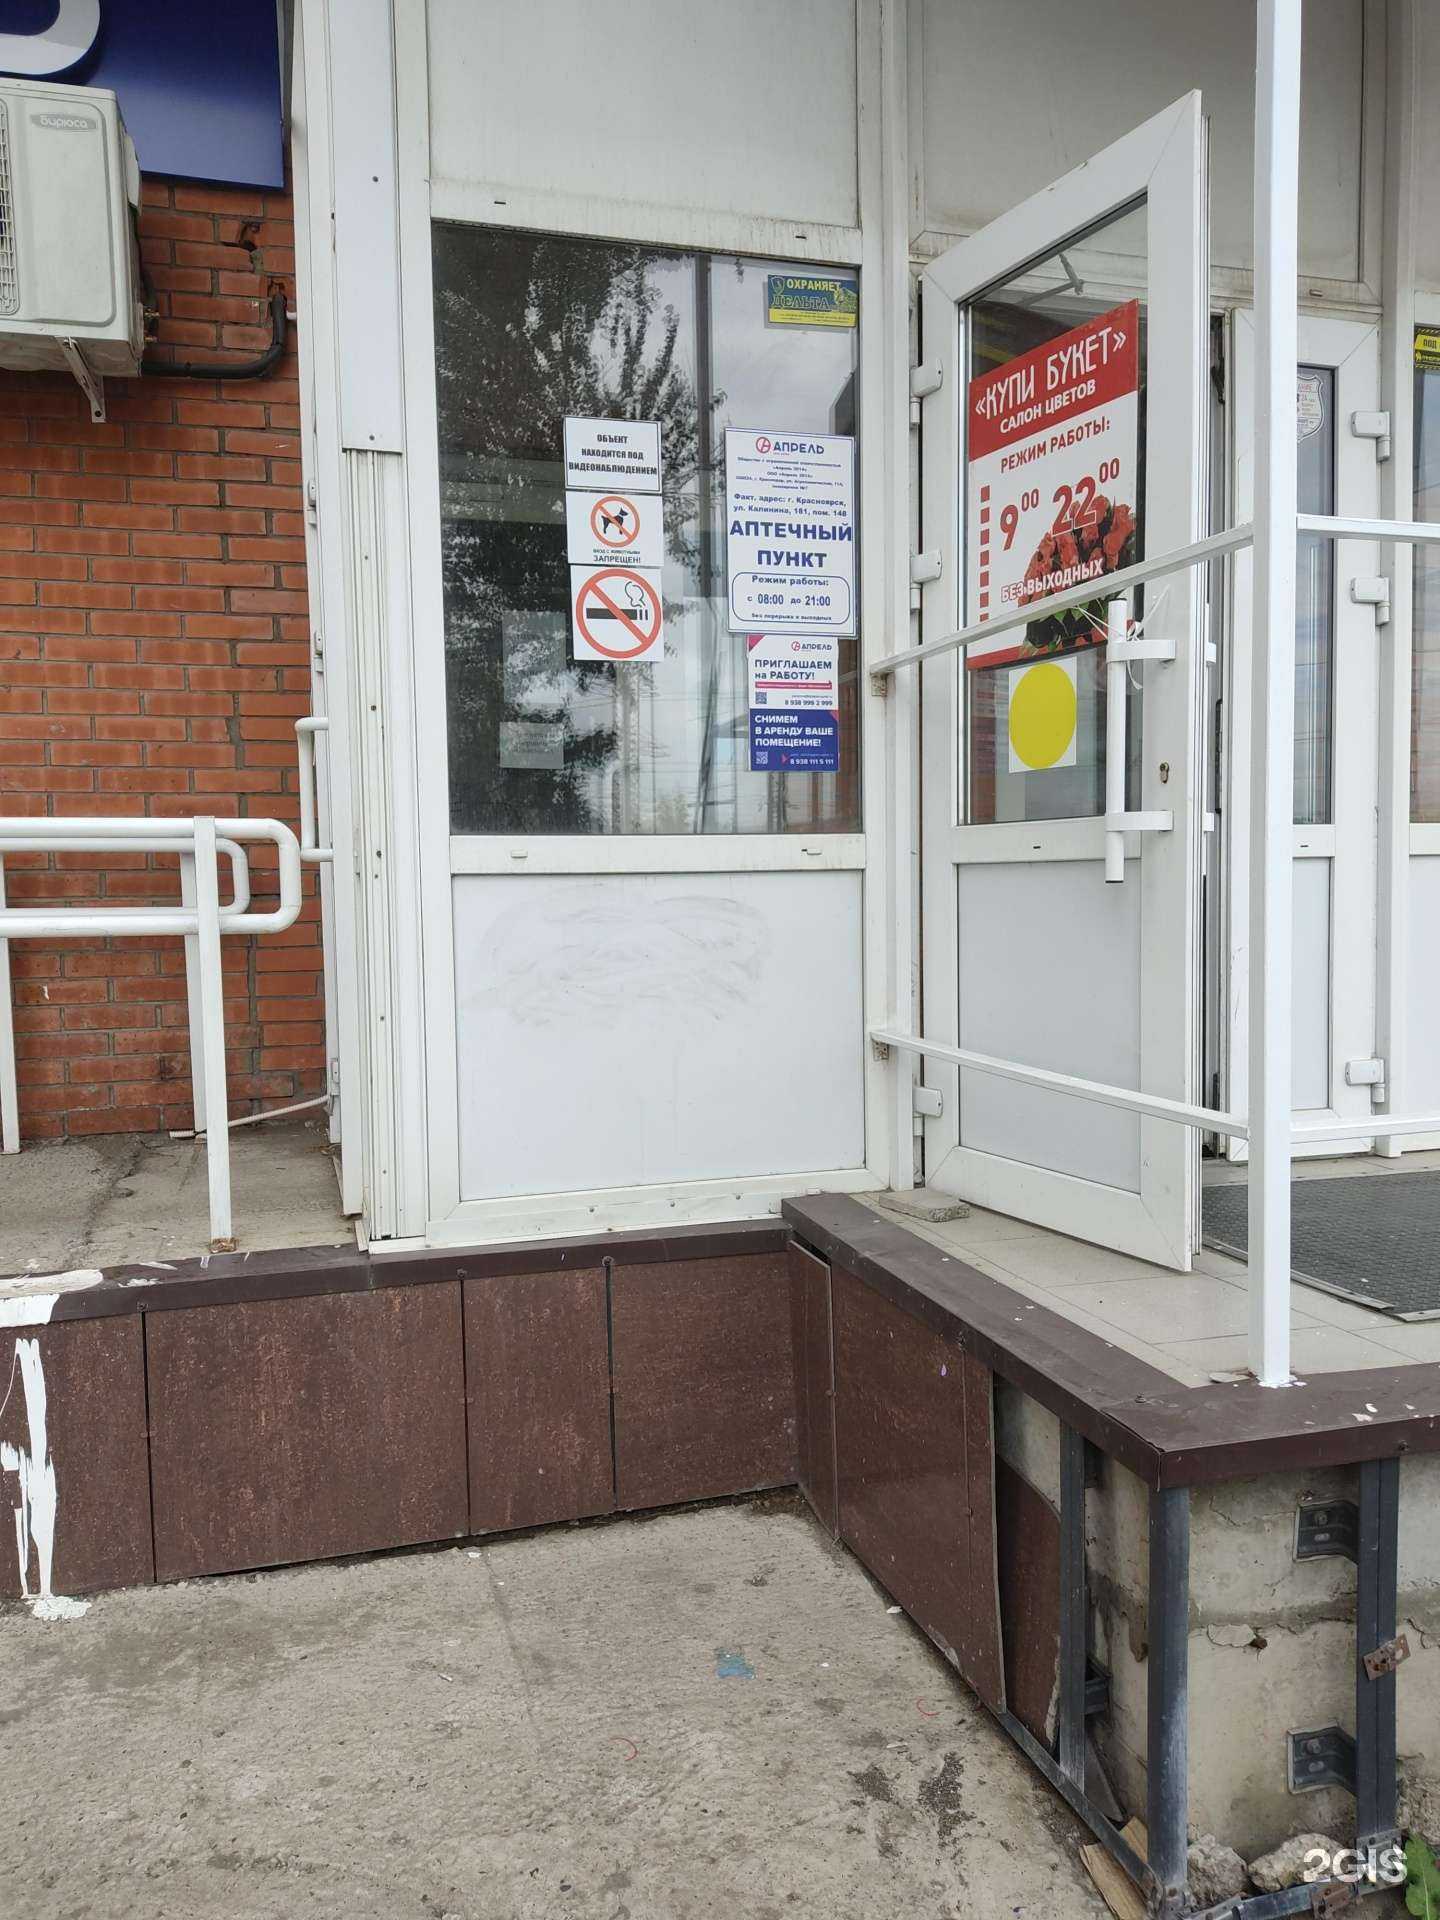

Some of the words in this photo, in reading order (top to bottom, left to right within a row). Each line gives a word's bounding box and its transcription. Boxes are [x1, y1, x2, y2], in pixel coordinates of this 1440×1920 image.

[787, 279, 841, 292] ОХРАНЯЕТ
[771, 294, 829, 310] ДЕЛЬТА
[975, 364, 1034, 420] «КУПИ
[1047, 326, 1127, 390] БУКЕТ»
[1000, 405, 1042, 433] САЛОН
[1045, 379, 1096, 415] ЦВЕТОВ
[597, 434, 628, 444] ОБЪЕКТ
[1001, 441, 1047, 473] РЕЖИМ
[1050, 417, 1110, 455] РАБОТЫ:
[774, 441, 824, 454] АПРЕЛЬ
[582, 448, 626, 459] НАХОДИТСЯ
[628, 451, 644, 460] ПОД
[569, 461, 657, 475] ВИДЕОНАБЛЮДЕНИЕМ
[734, 493, 756, 501] Факт.
[759, 495, 785, 504] адрес:
[796, 498, 846, 507] Красноярск,
[748, 505, 792, 515] Калинина,
[730, 520, 852, 541] АПТЕЧНЫЙ
[593, 555, 641, 564] ЗАПРЕЩЕН!
[757, 550, 827, 567] ПУНКТ
[752, 575, 786, 585] Режим
[790, 576, 829, 586] работы:
[1001, 579, 1025, 603] БЕЗ
[1026, 557, 1103, 597] ВЫХОДНЫХ
[758, 594, 784, 605] 08:00
[805, 595, 831, 606] 21:00
[801, 643, 832, 651] АПРЕЛЬ
[755, 659, 832, 669] ПРИГЛАШАЕМ
[770, 671, 814, 680] РАБОТУ!
[755, 715, 798, 723] СНИМЕМ
[755, 727, 762, 735] В
[764, 728, 802, 736] АРЕНДУ
[755, 738, 821, 748] ПОМЕЩЕНИЕ!
